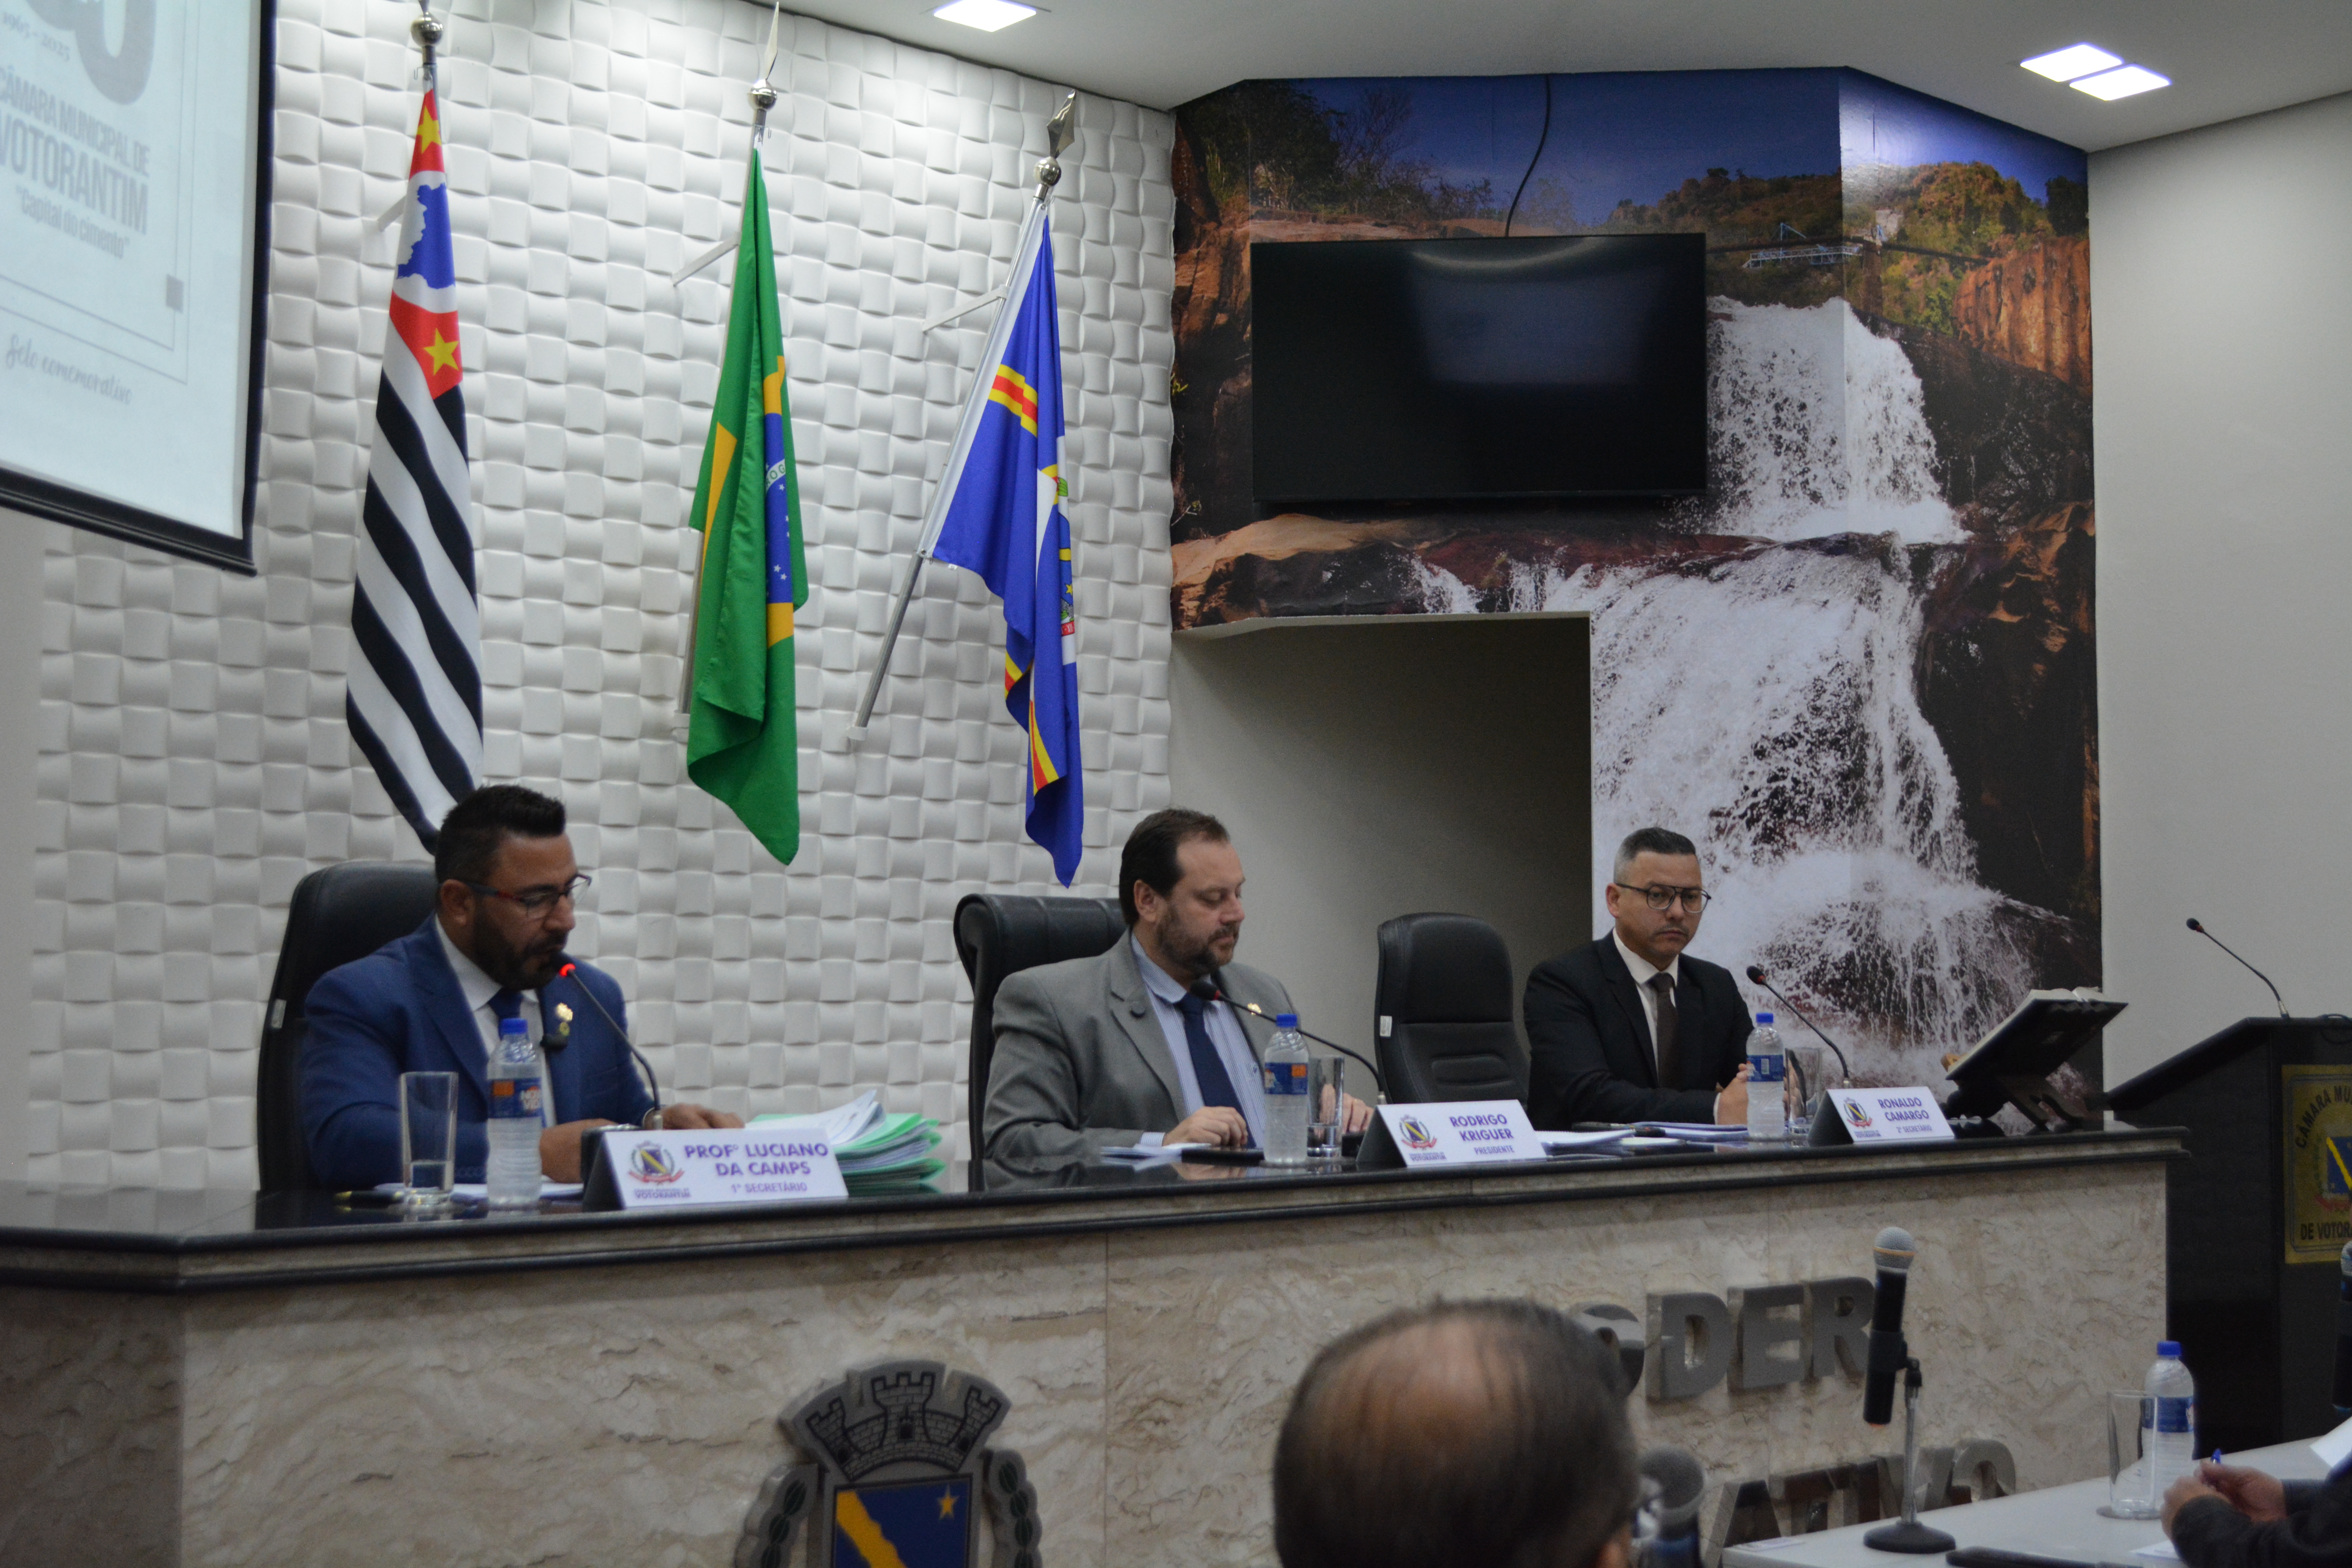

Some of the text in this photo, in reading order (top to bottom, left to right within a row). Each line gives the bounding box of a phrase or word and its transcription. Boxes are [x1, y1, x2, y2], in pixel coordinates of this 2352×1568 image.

[60, 100, 131, 168] MUNICIPAL
[133, 140, 151, 178] DE
[1877, 1097, 1922, 1109] RONALDO
[1449, 1114, 1508, 1127] RODRIGO
[1884, 1110, 1929, 1122] CAMARGO
[1902, 1123, 1933, 1132] SECRETÁRIO
[1459, 1128, 1514, 1141] KRIGUER
[745, 1143, 829, 1158] LUCIANO
[1474, 1145, 1515, 1154] PRESIDENTE
[715, 1161, 811, 1176] DA CAMPS
[746, 1181, 808, 1192] SECRETÁRIO
[2300, 1223, 2314, 1240] DE
